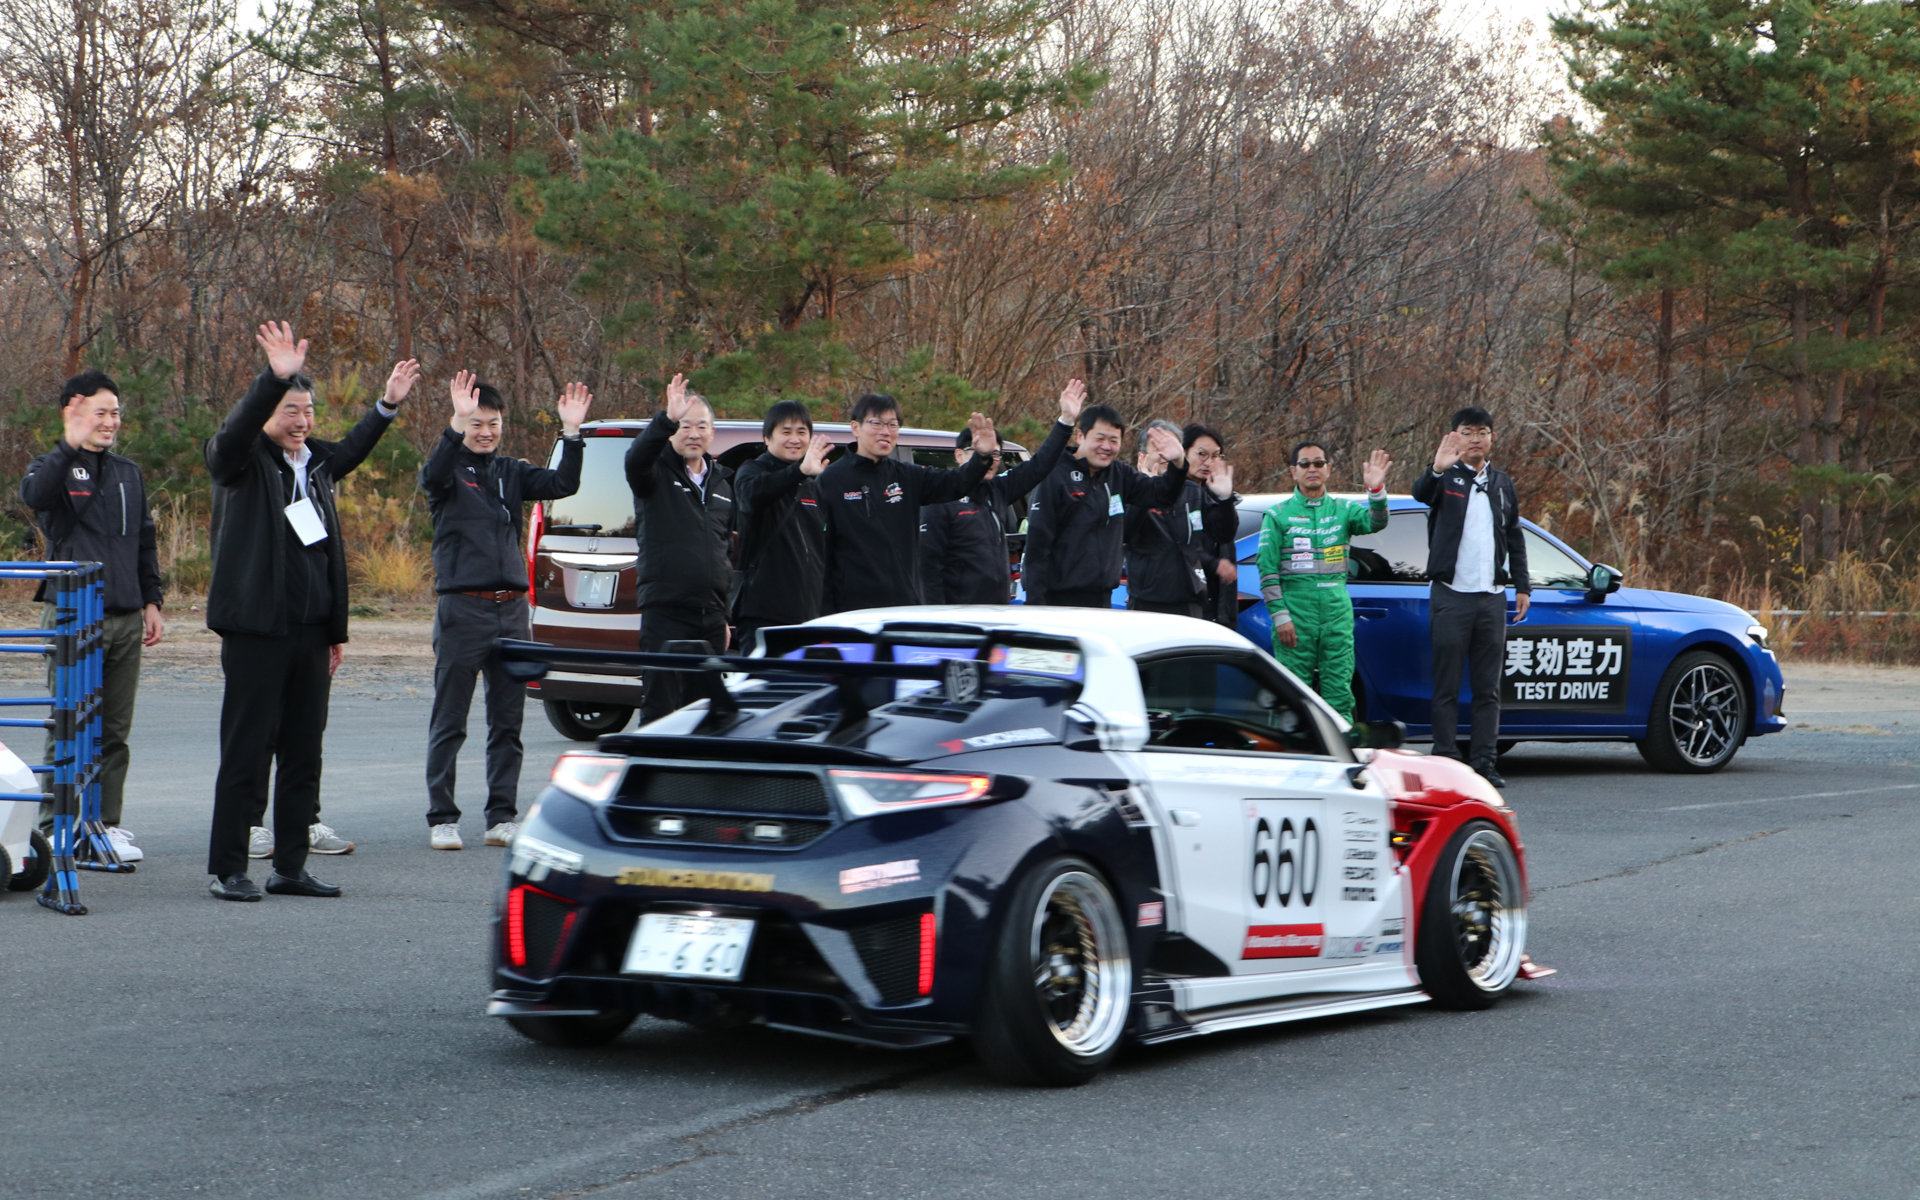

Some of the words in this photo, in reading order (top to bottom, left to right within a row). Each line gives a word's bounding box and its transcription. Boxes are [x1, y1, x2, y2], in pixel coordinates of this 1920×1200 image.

[1286, 525, 1342, 535] Modulo
[1504, 637, 1623, 677] 実効空力
[1514, 682, 1557, 700] TEST
[1559, 682, 1610, 700] DRIVE
[1252, 816, 1321, 909] 660
[671, 940, 744, 974] 660
